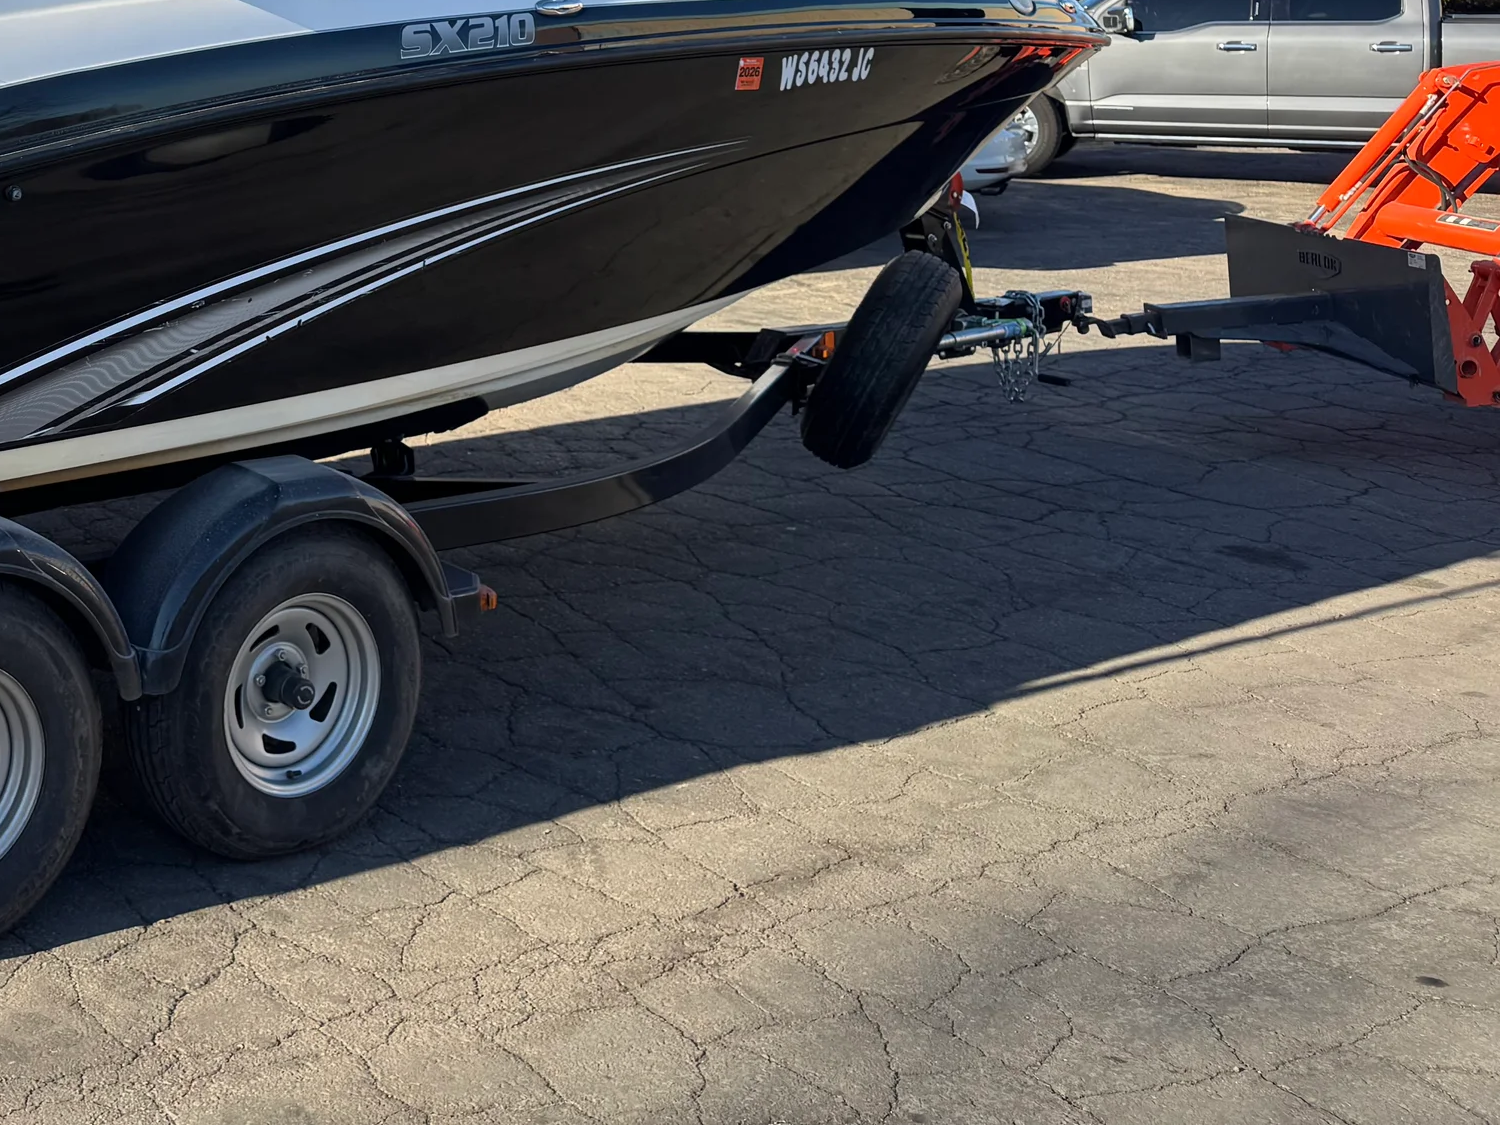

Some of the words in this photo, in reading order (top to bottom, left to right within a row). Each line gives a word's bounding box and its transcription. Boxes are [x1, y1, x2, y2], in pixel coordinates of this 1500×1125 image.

[400, 12, 536, 59] SX210
[739, 66, 761, 78] 2026
[851, 47, 875, 82] JC
